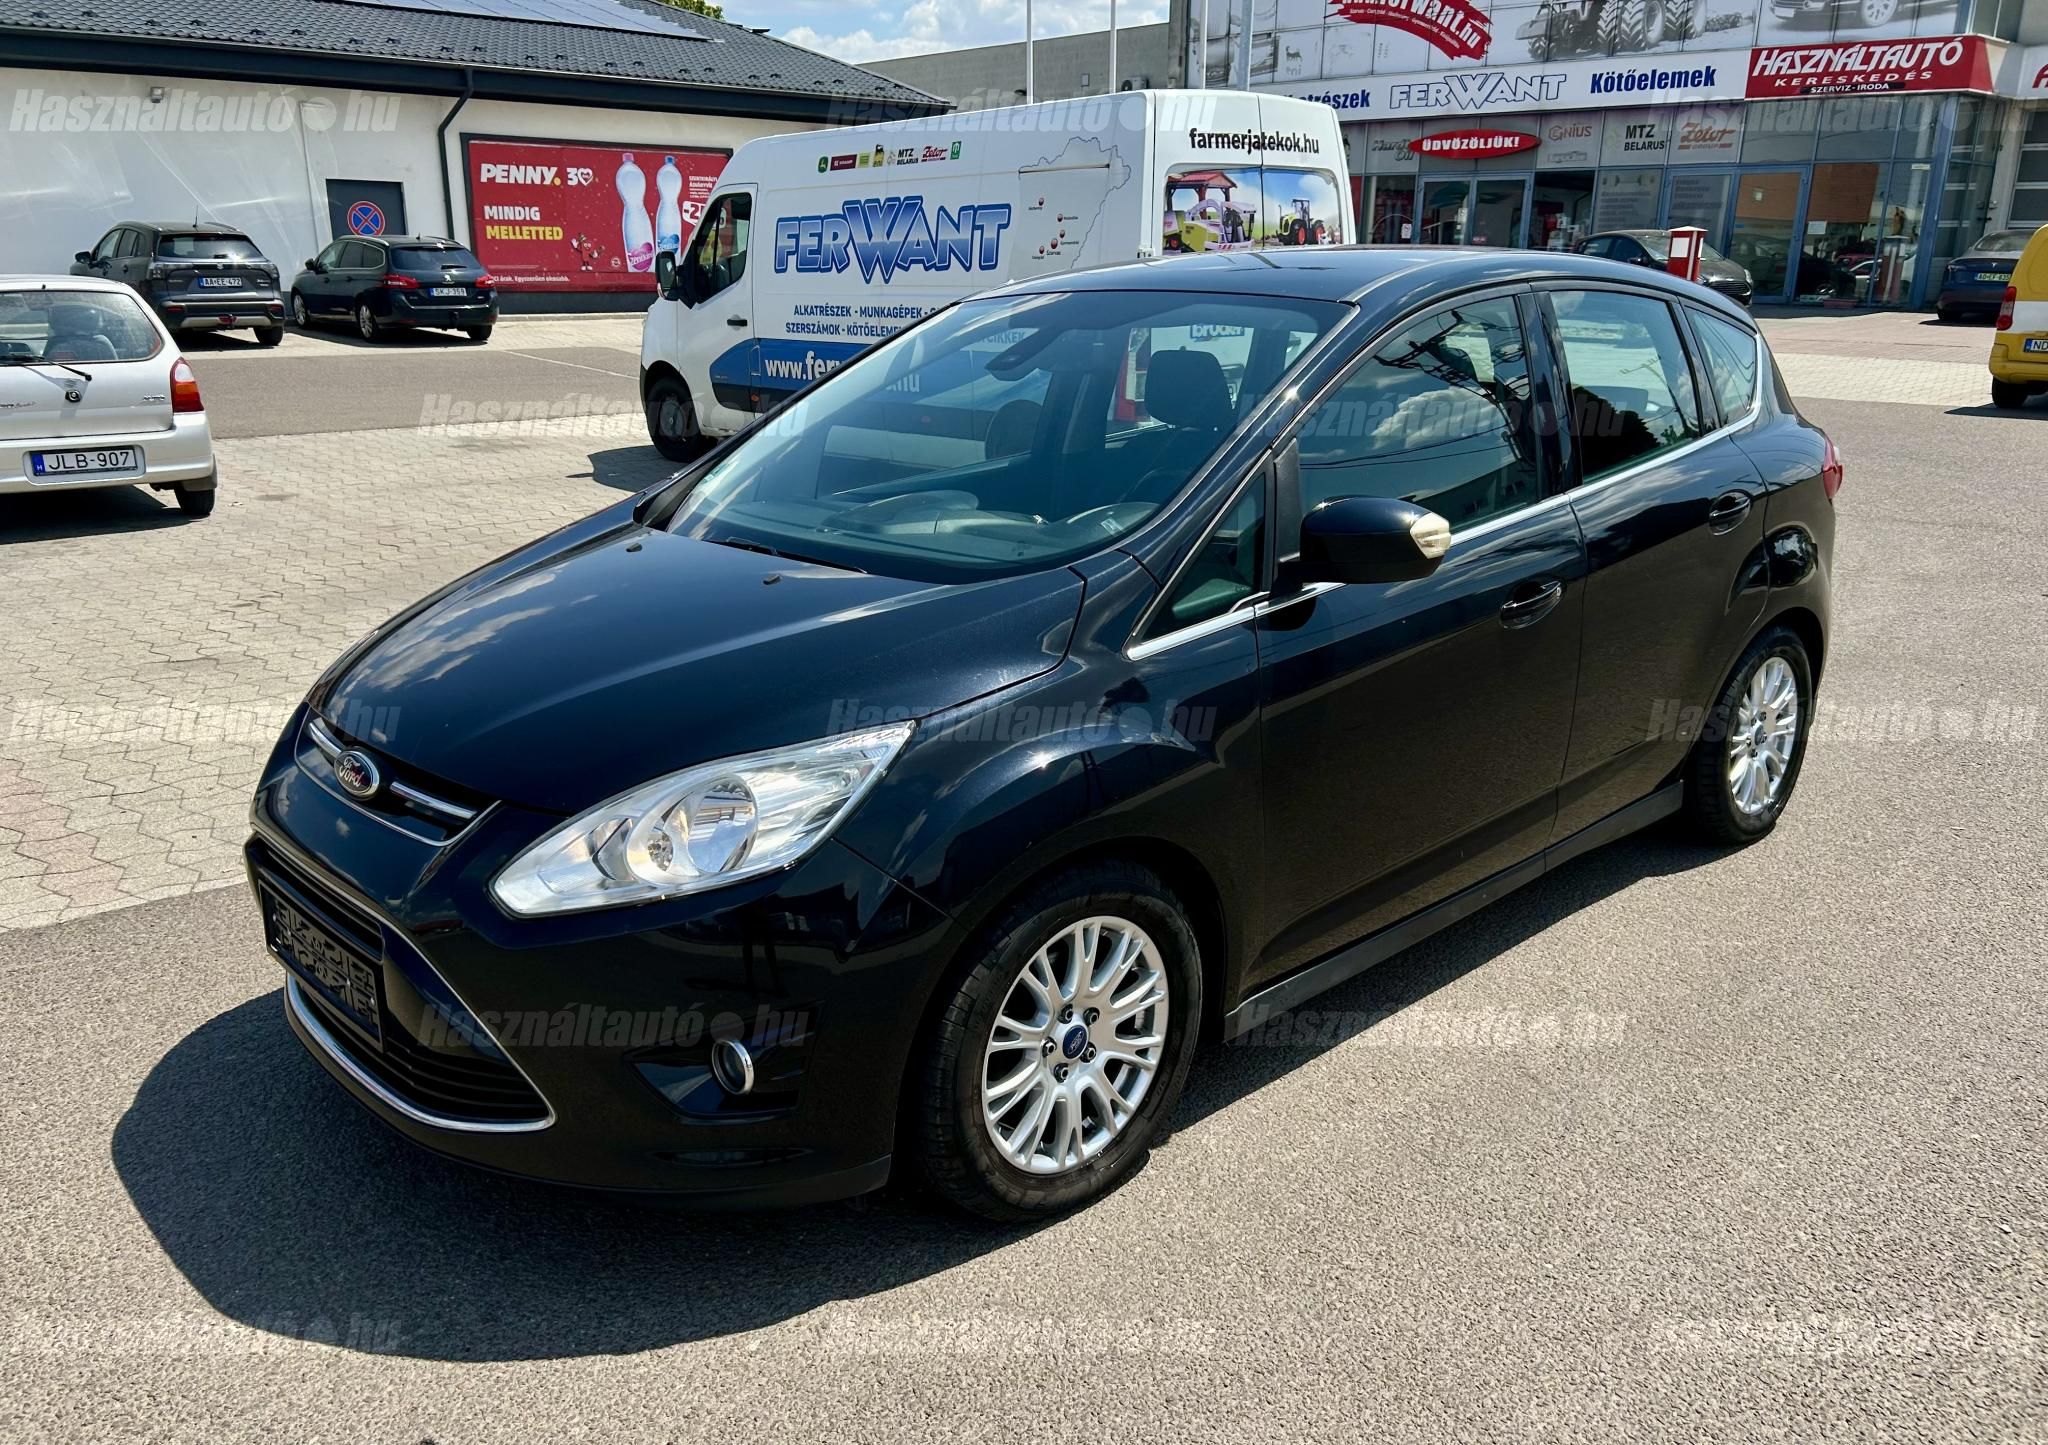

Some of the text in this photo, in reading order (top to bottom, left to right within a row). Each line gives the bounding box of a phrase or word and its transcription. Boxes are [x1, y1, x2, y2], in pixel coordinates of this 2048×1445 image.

[1753, 38, 1964, 77] HASZNÁLTAUTÓ
[1590, 66, 1717, 94] Kötőelemek
[1775, 70, 1932, 87] KERESKEDÉS
[1390, 73, 1567, 110] FERWANT
[1625, 124, 1656, 139] MTZ
[1189, 128, 1320, 155] farmerjatekok.hu
[1422, 136, 1520, 151] ÜDVÖZÖLJÜK!
[1623, 140, 1665, 151] BELARUS
[897, 148, 914, 158] MTZ
[484, 205, 541, 221] MINDIG
[486, 226, 563, 241] MELLETTED
[774, 195, 1011, 284] FERWANT
[794, 302, 922, 319] ALKATRÉSZEK MUNKAGÉPEK
[785, 320, 840, 335] SZERSZÁMOK
[48, 451, 130, 470] JLB-907
[339, 756, 366, 787] Ford
